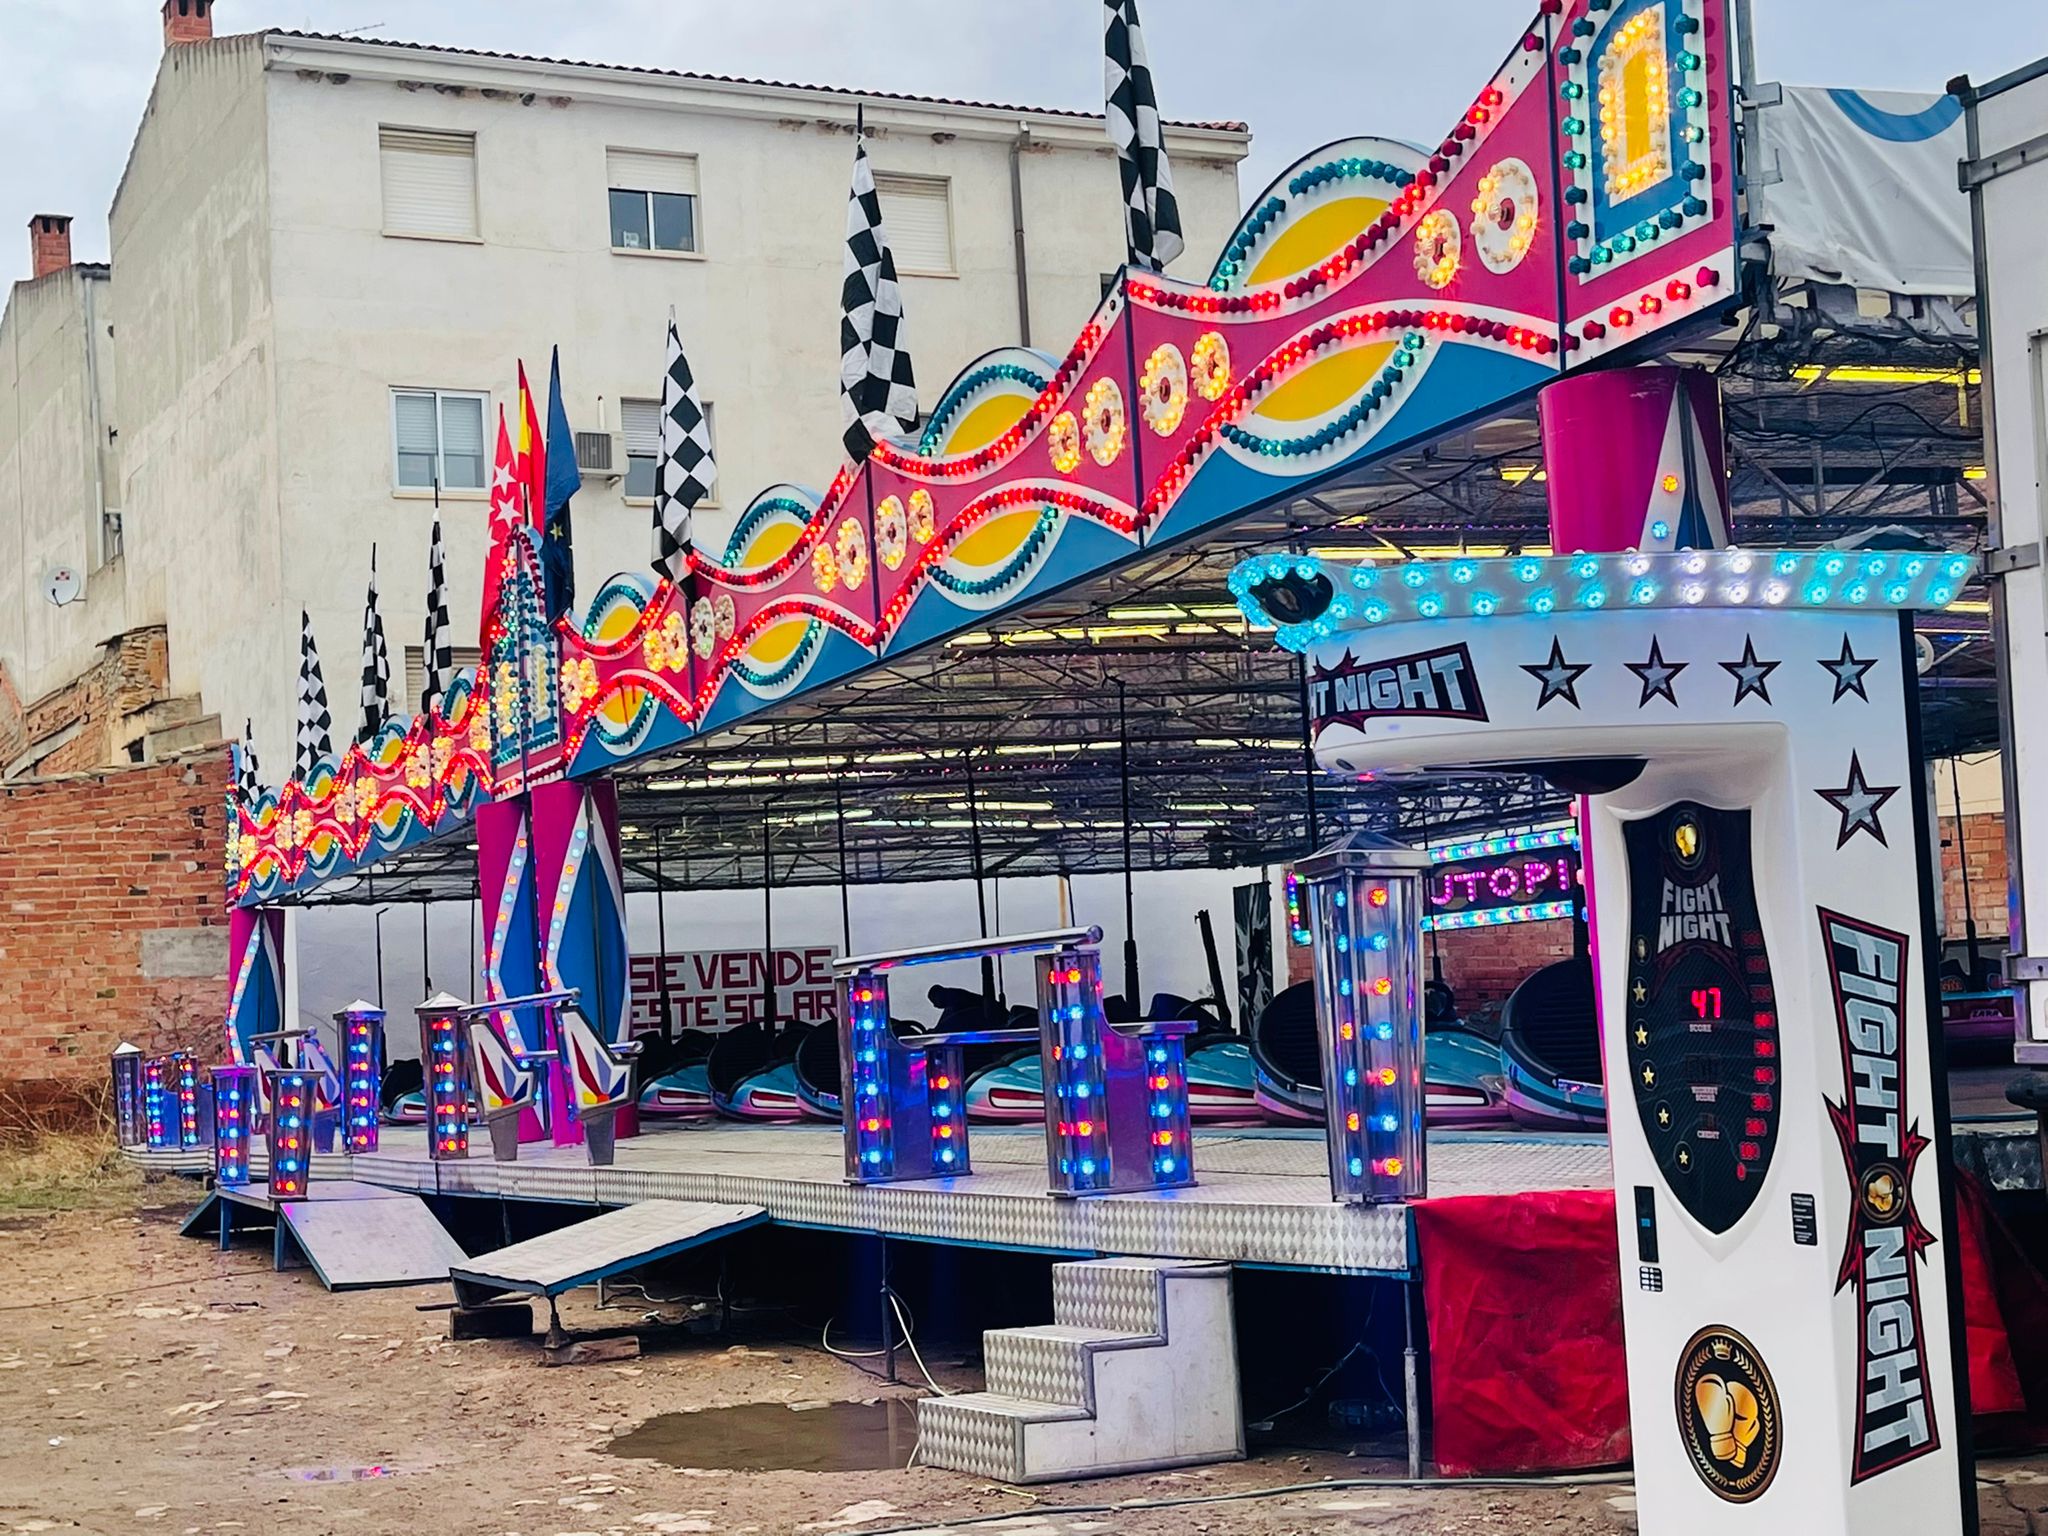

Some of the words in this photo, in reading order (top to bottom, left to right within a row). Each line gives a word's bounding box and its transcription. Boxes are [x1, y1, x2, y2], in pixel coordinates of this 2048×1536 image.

[1334, 652, 1466, 713] NIGHT
[1661, 873, 1723, 913] FIGHT
[1657, 913, 1733, 954] NIGHT
[629, 955, 686, 993] SE
[692, 949, 833, 990] VENDE
[1691, 987, 1721, 1018] 47
[1830, 922, 1899, 1159] FIGHT
[1863, 1226, 1930, 1453] NIGHT
